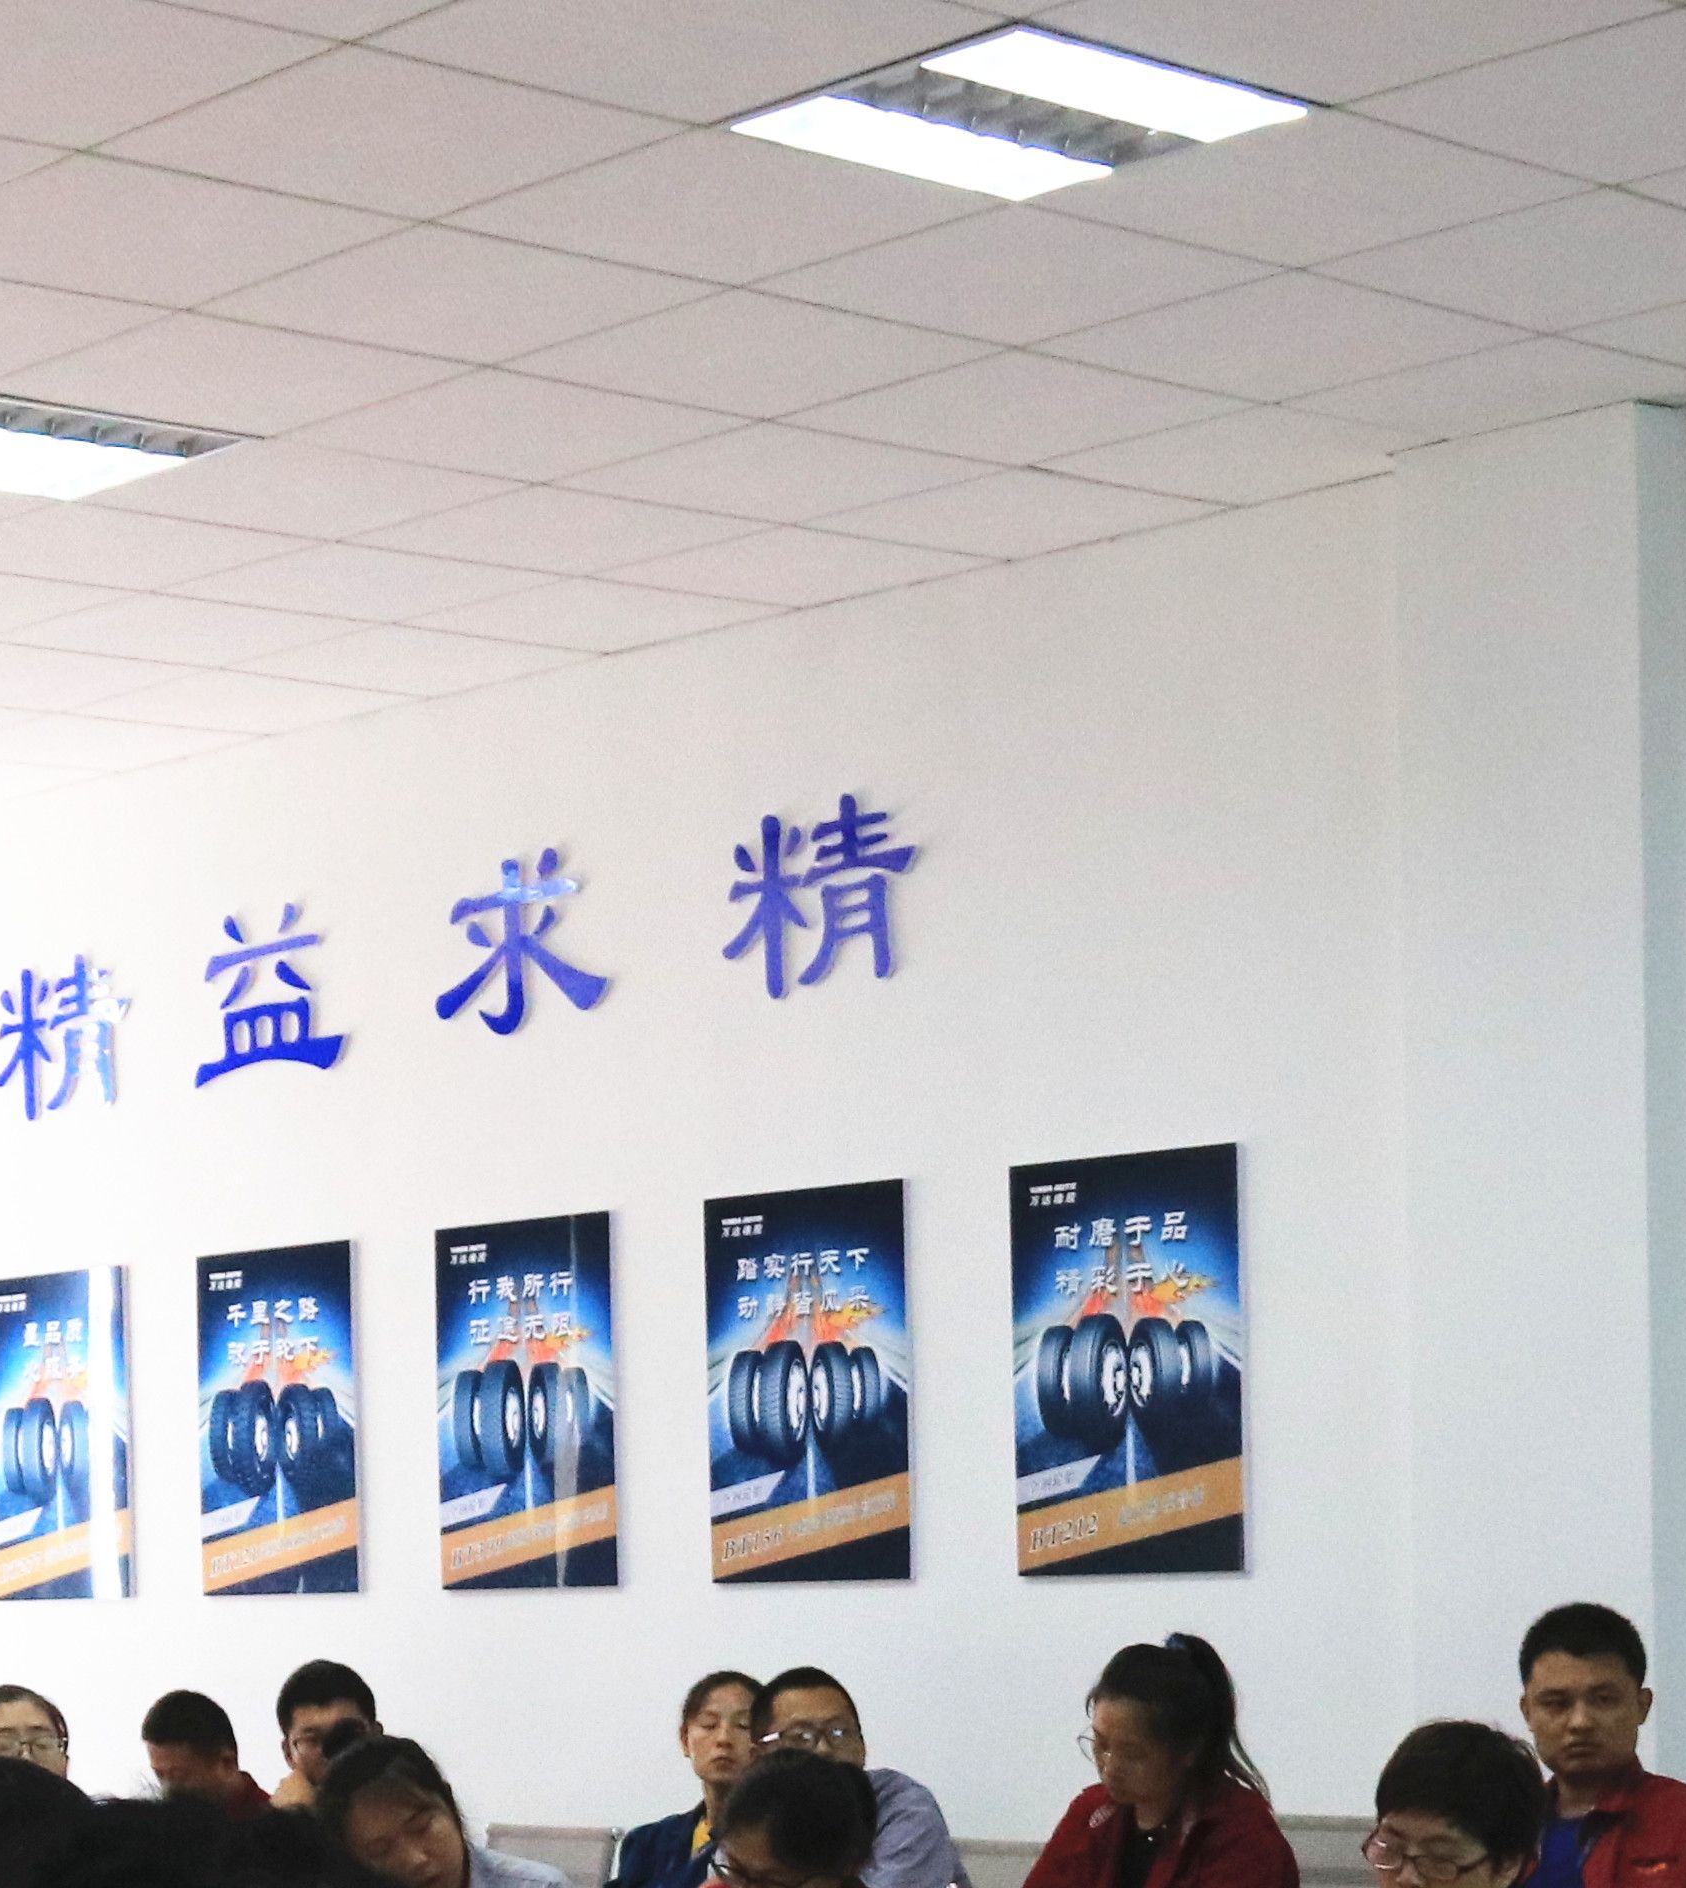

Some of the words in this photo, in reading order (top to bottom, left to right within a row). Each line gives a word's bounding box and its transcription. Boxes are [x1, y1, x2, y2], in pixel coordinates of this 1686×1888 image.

[1053, 1211, 1190, 1250] 耐磨于品
[467, 1270, 574, 1305] 行我所行
[1055, 1259, 1191, 1296] 精彩于心
